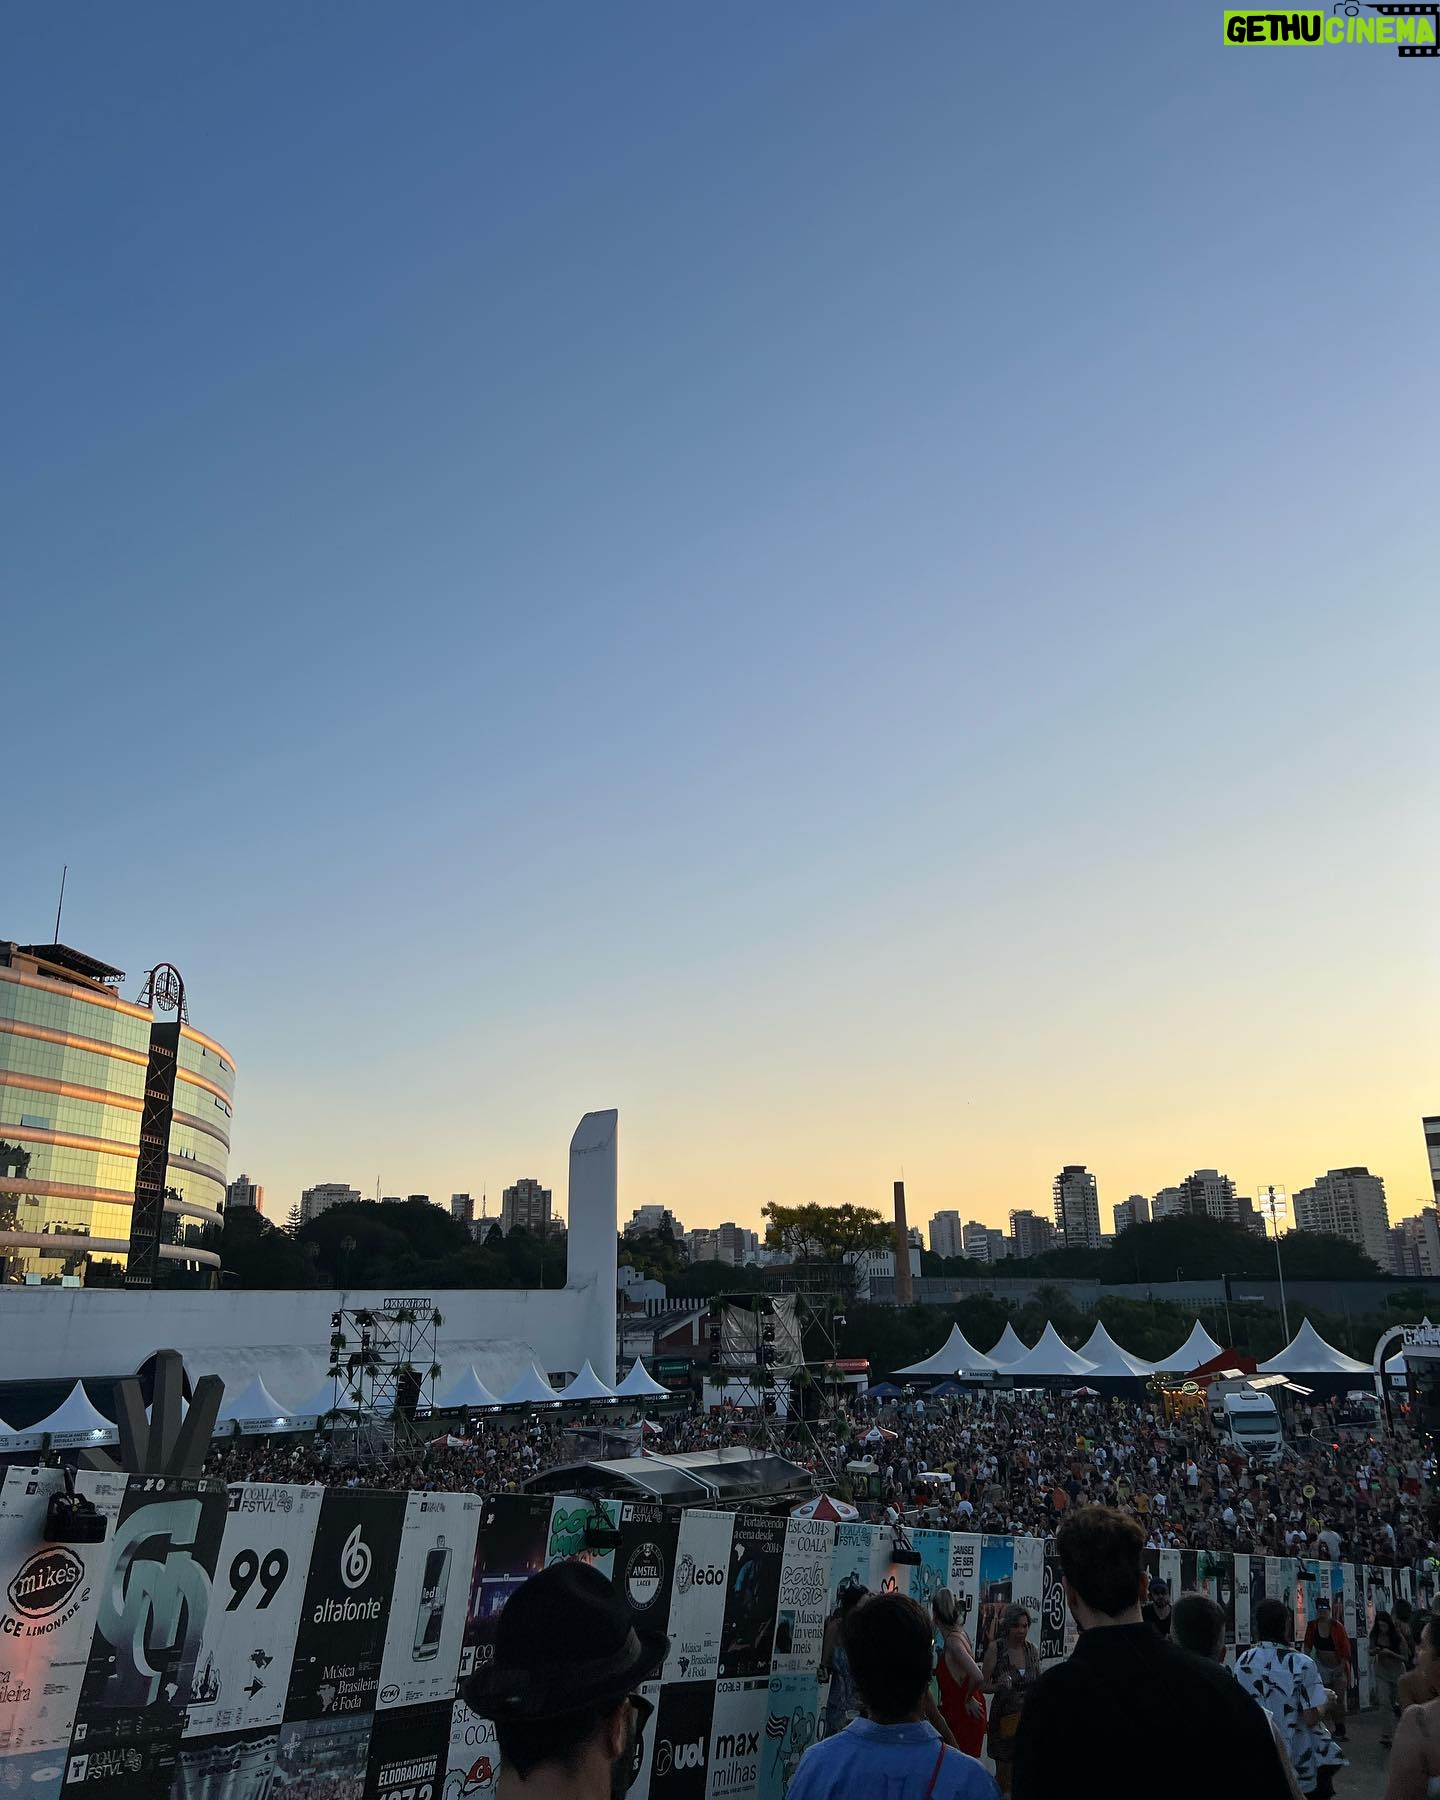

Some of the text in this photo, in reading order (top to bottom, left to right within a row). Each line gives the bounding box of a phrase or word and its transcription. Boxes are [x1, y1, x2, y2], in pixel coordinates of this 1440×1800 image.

[241, 1501, 275, 1513] FSTVL
[798, 1537, 827, 1552] COALA
[18, 1563, 76, 1597] mike's
[225, 1549, 289, 1611] 99
[632, 1566, 657, 1576] AMSTEL
[692, 1565, 724, 1585] leão
[26, 1602, 80, 1636] LIMONADE
[313, 1597, 381, 1623] altafonte
[322, 1664, 355, 1680] Música
[337, 1677, 378, 1694] Brasileira
[332, 1695, 361, 1711] é Foda
[464, 1722, 497, 1745] COA
[716, 1731, 759, 1759] max
[87, 1763, 124, 1780] FSTVL
[713, 1761, 757, 1787] milhas
